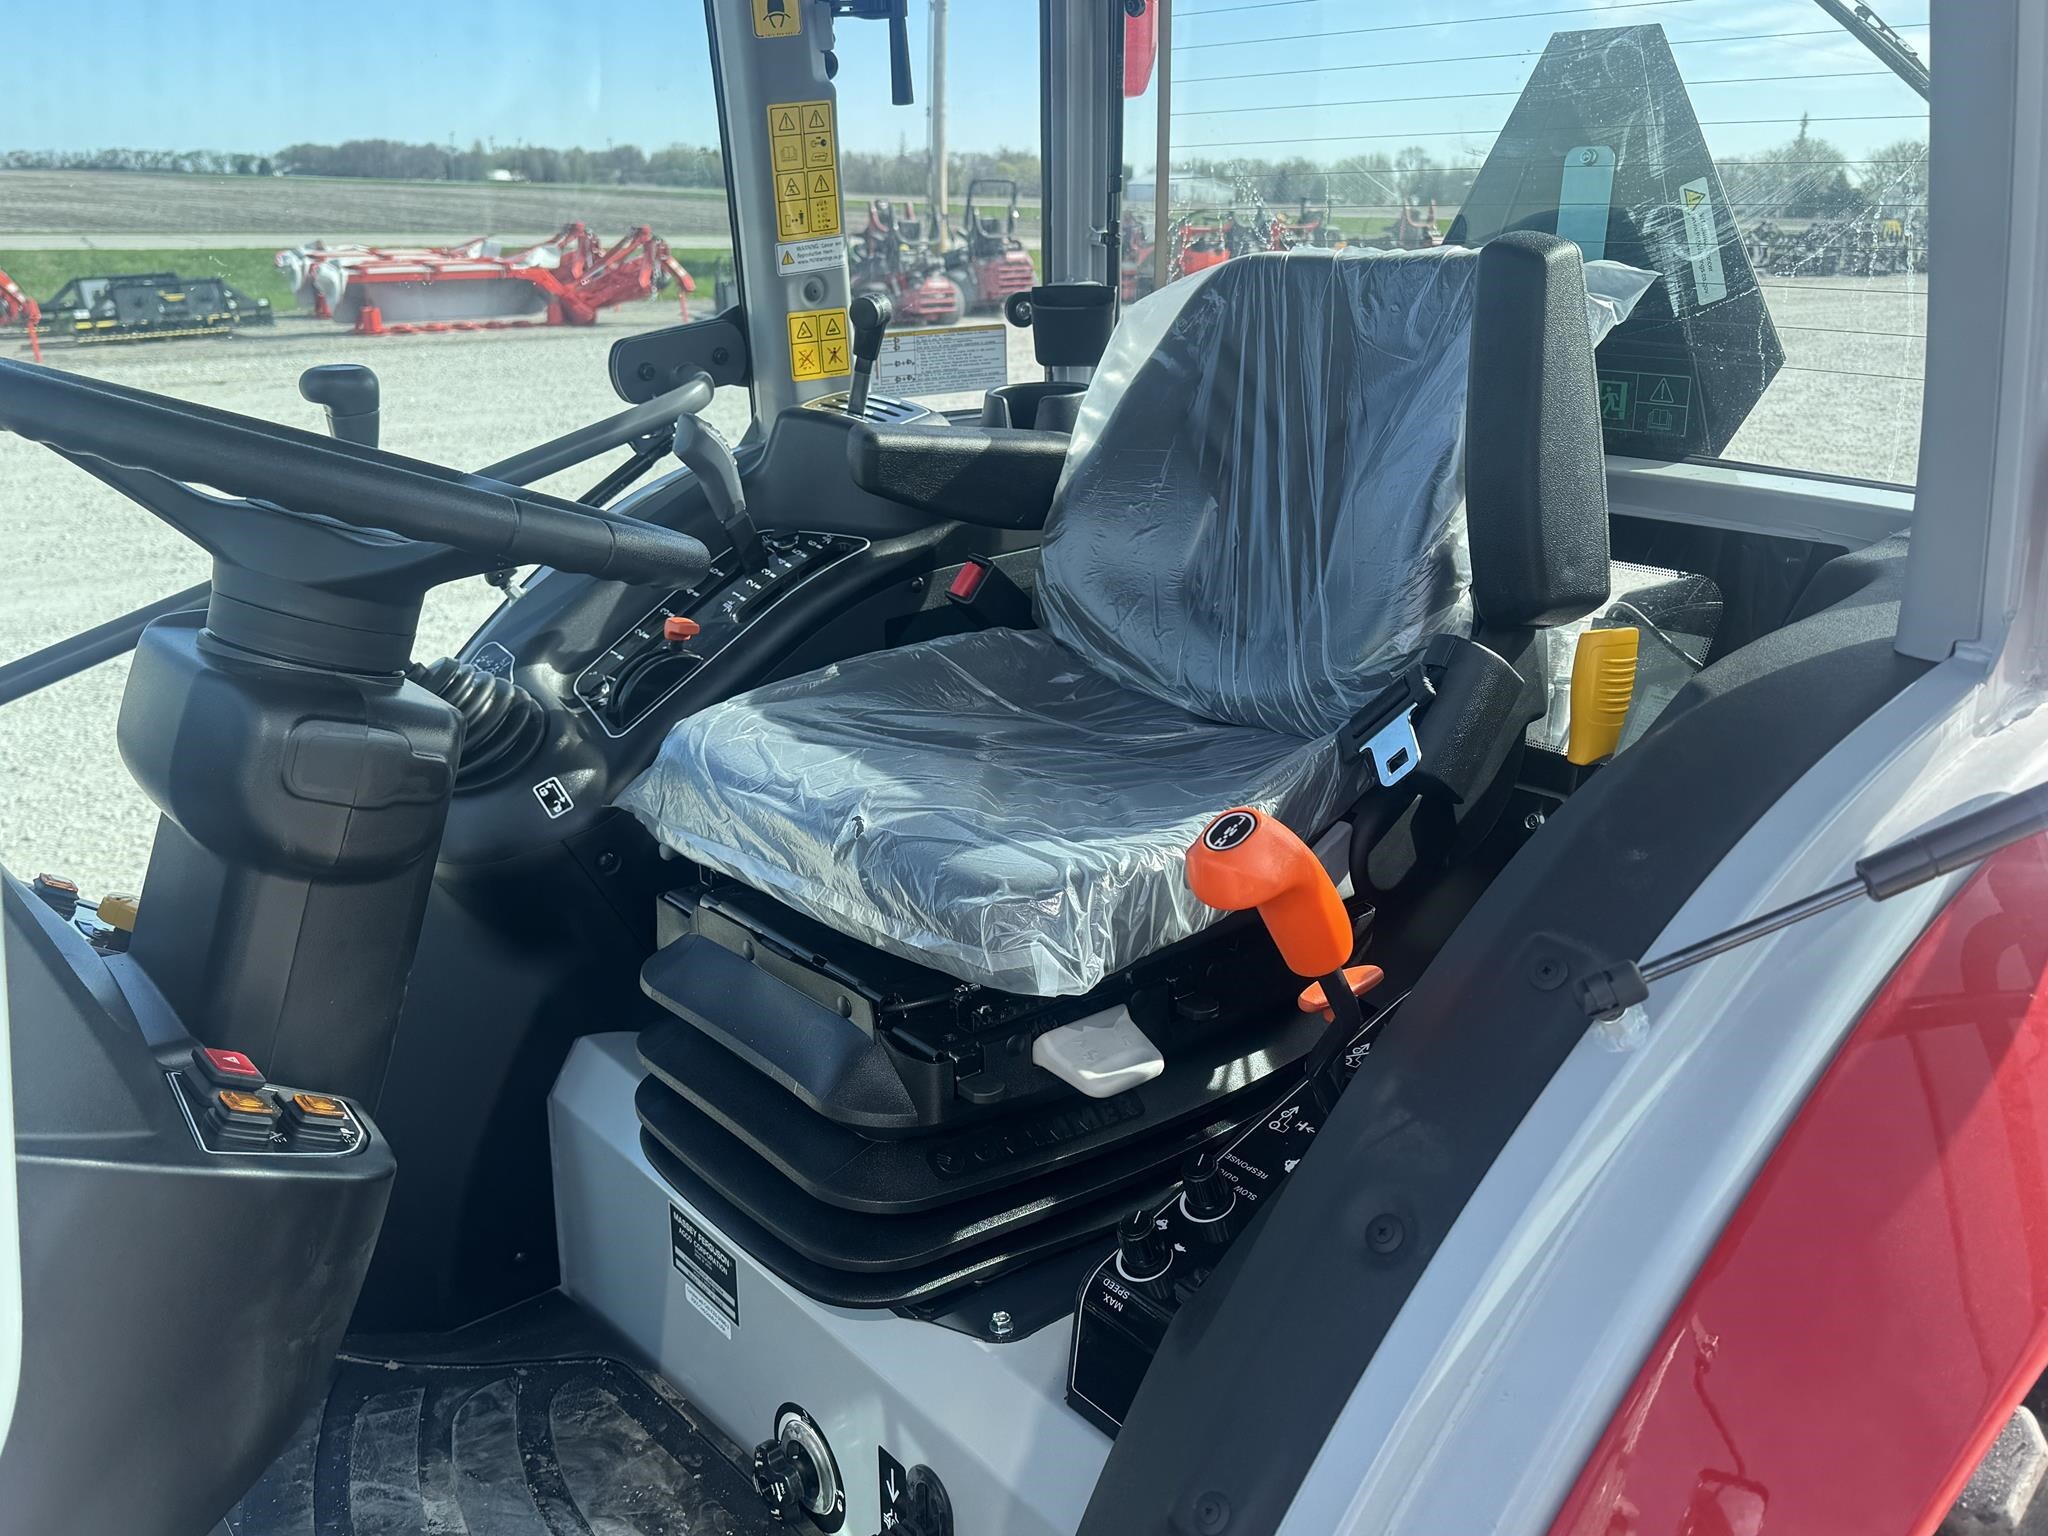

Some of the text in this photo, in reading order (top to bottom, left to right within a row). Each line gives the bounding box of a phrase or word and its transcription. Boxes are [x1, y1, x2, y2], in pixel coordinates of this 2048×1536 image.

[761, 568, 772, 576] 3
[745, 579, 756, 588] 2
[1224, 1153, 1269, 1180] RESPONSE
[1233, 1185, 1258, 1201] SLOW
[1103, 1277, 1130, 1300] SPEED
[1102, 1291, 1124, 1312] MAX.
